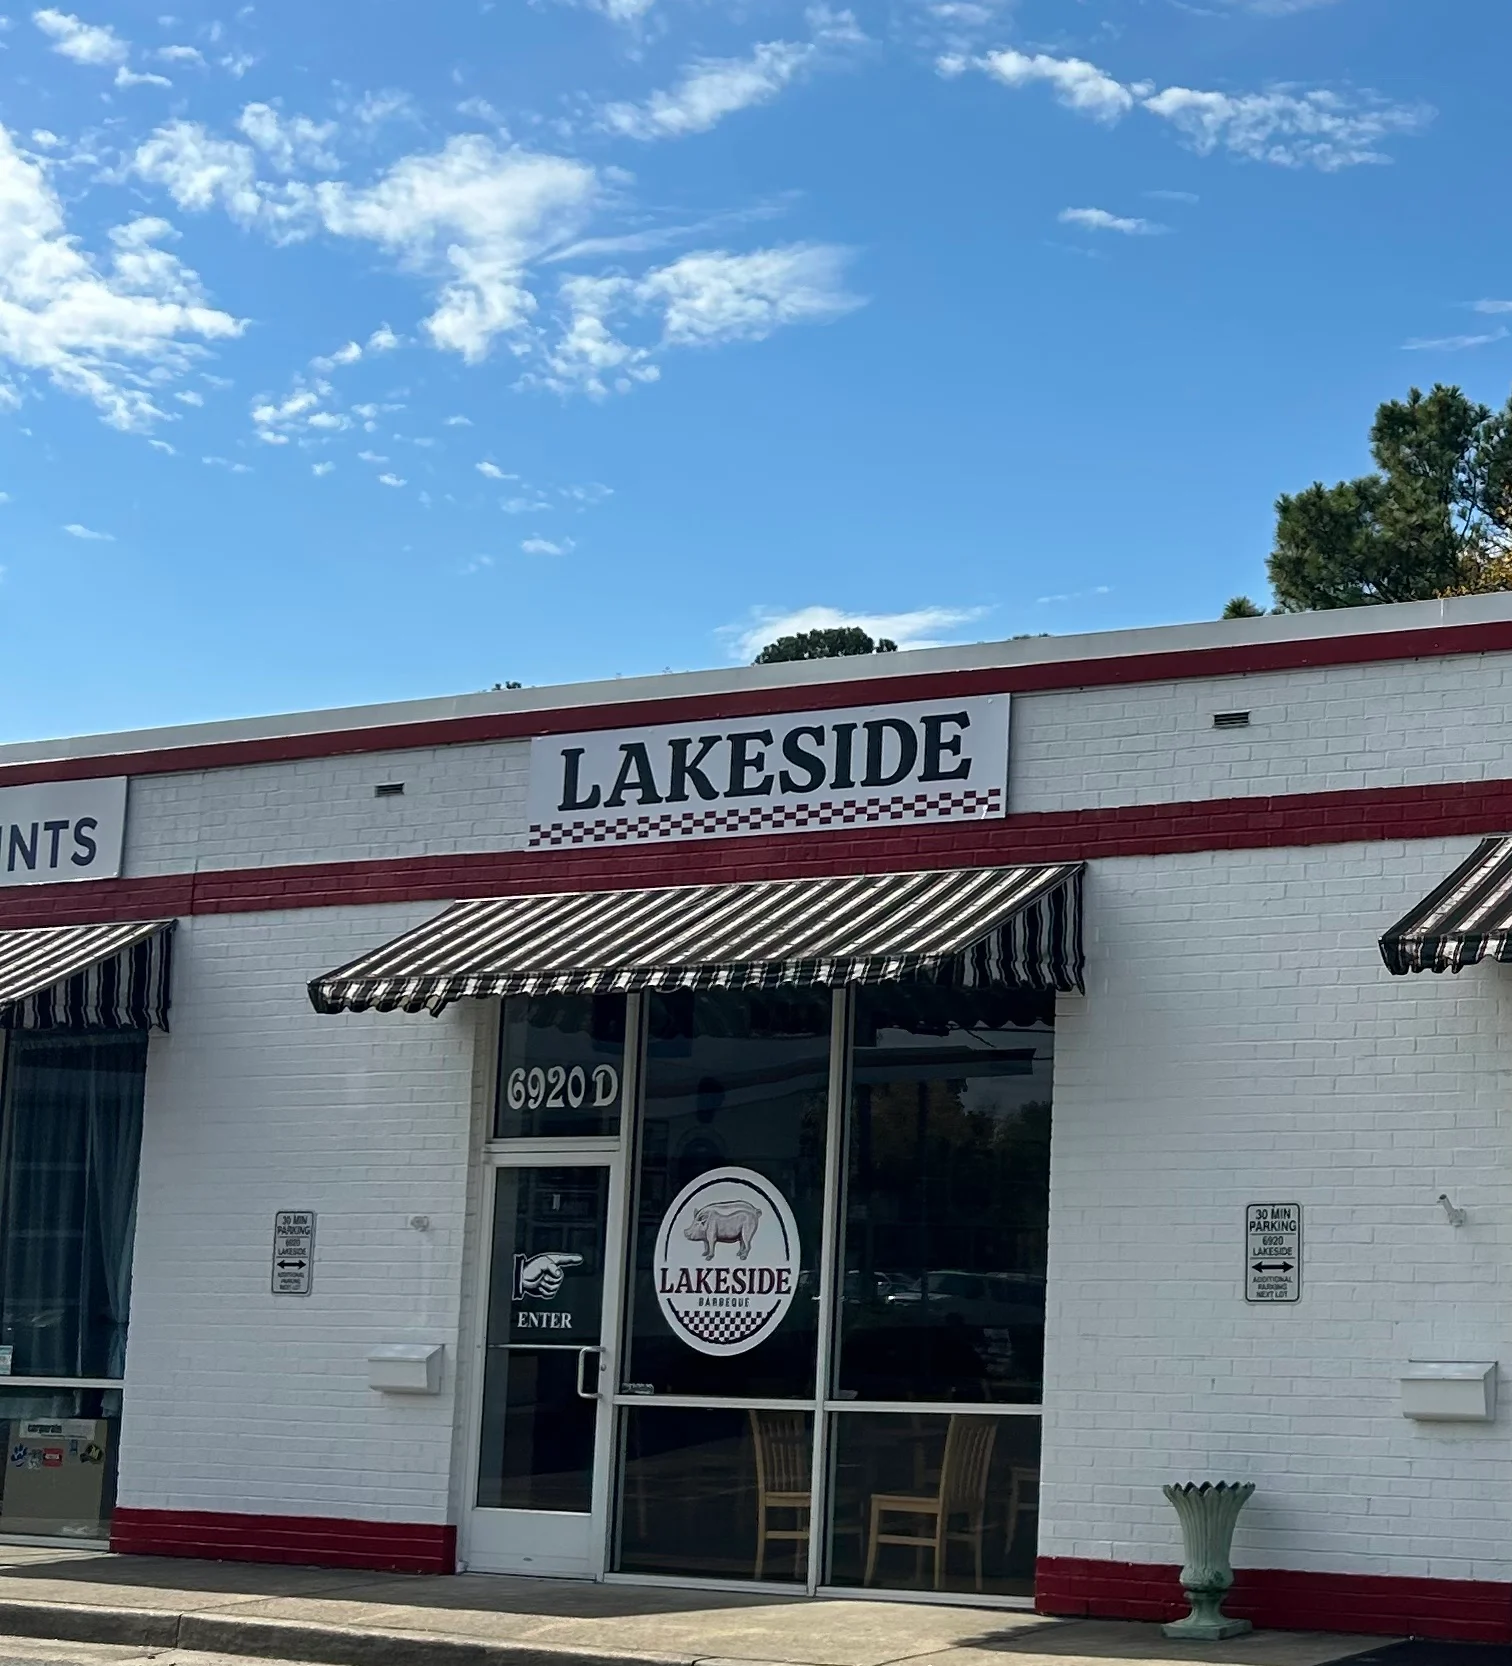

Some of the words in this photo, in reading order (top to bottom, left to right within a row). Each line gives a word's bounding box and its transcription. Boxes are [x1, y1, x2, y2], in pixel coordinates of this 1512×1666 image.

[557, 710, 973, 812] LAKESIDE
[0, 817, 98, 872] NTS
[507, 1065, 586, 1110] 6920
[591, 1063, 619, 1107] D
[1255, 1208, 1268, 1220] 30
[1271, 1208, 1291, 1219] MIN
[277, 1225, 311, 1235] PARKING
[1249, 1220, 1297, 1232] PARKING
[1262, 1236, 1284, 1246] 6920
[1252, 1247, 1293, 1256] LAKESIDE
[659, 1267, 792, 1295] LAKESIDE
[698, 1297, 750, 1308] BARBEQUE
[517, 1311, 573, 1330] ENTER
